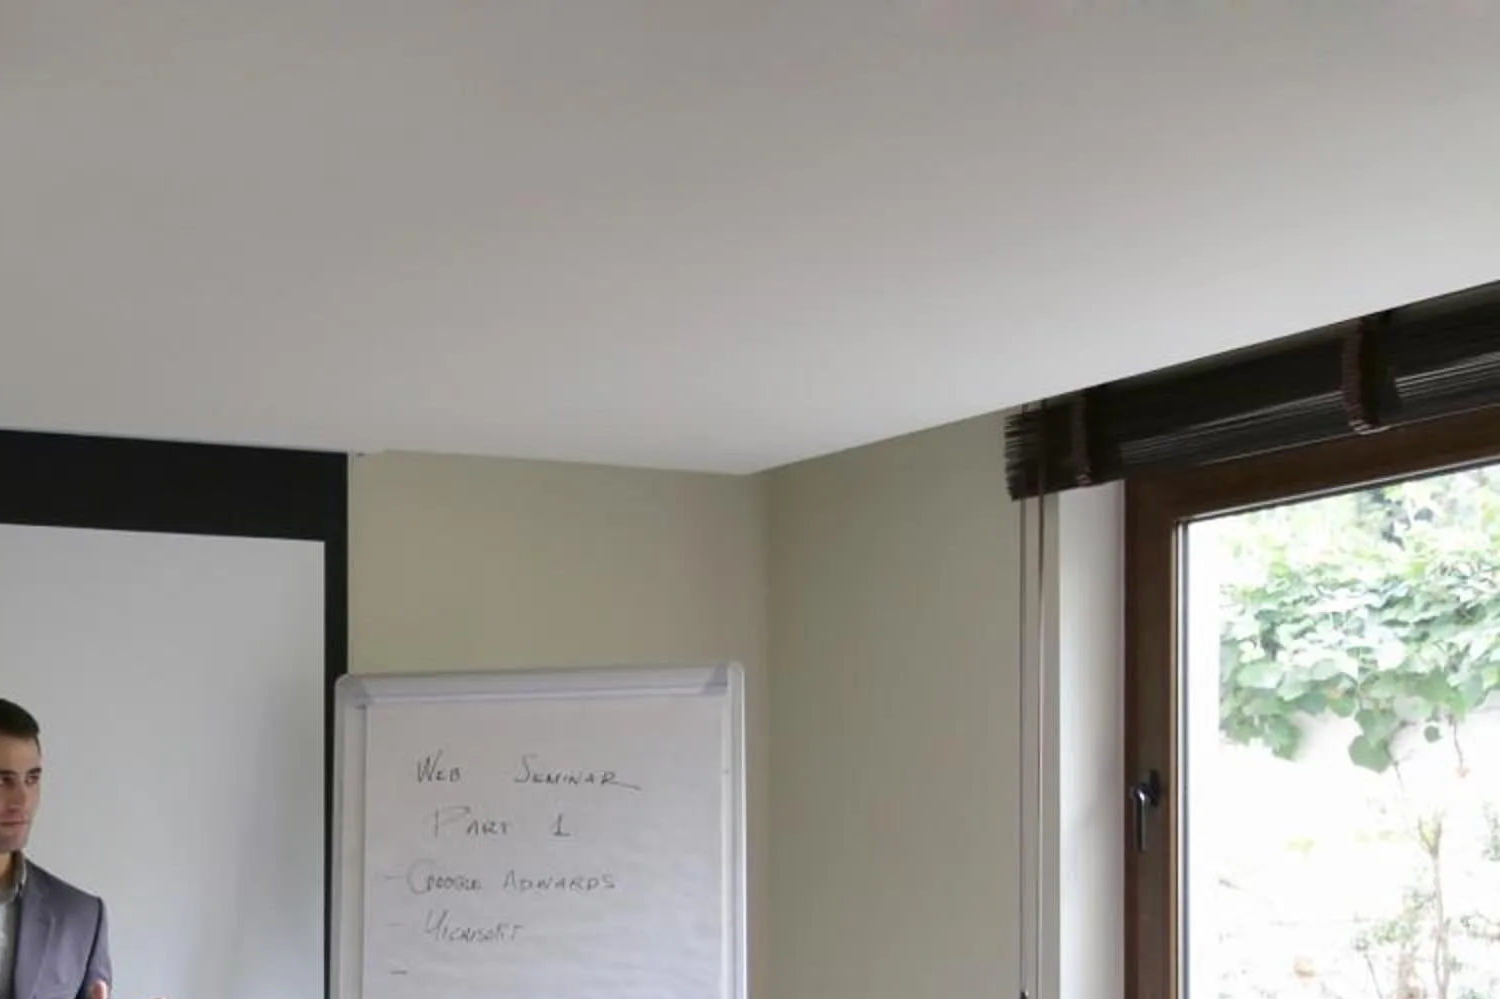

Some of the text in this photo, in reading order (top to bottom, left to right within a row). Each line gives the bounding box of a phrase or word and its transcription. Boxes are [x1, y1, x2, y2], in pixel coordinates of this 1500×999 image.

[416, 749, 643, 792] WEB SEMINAR
[432, 805, 572, 839] PART 1
